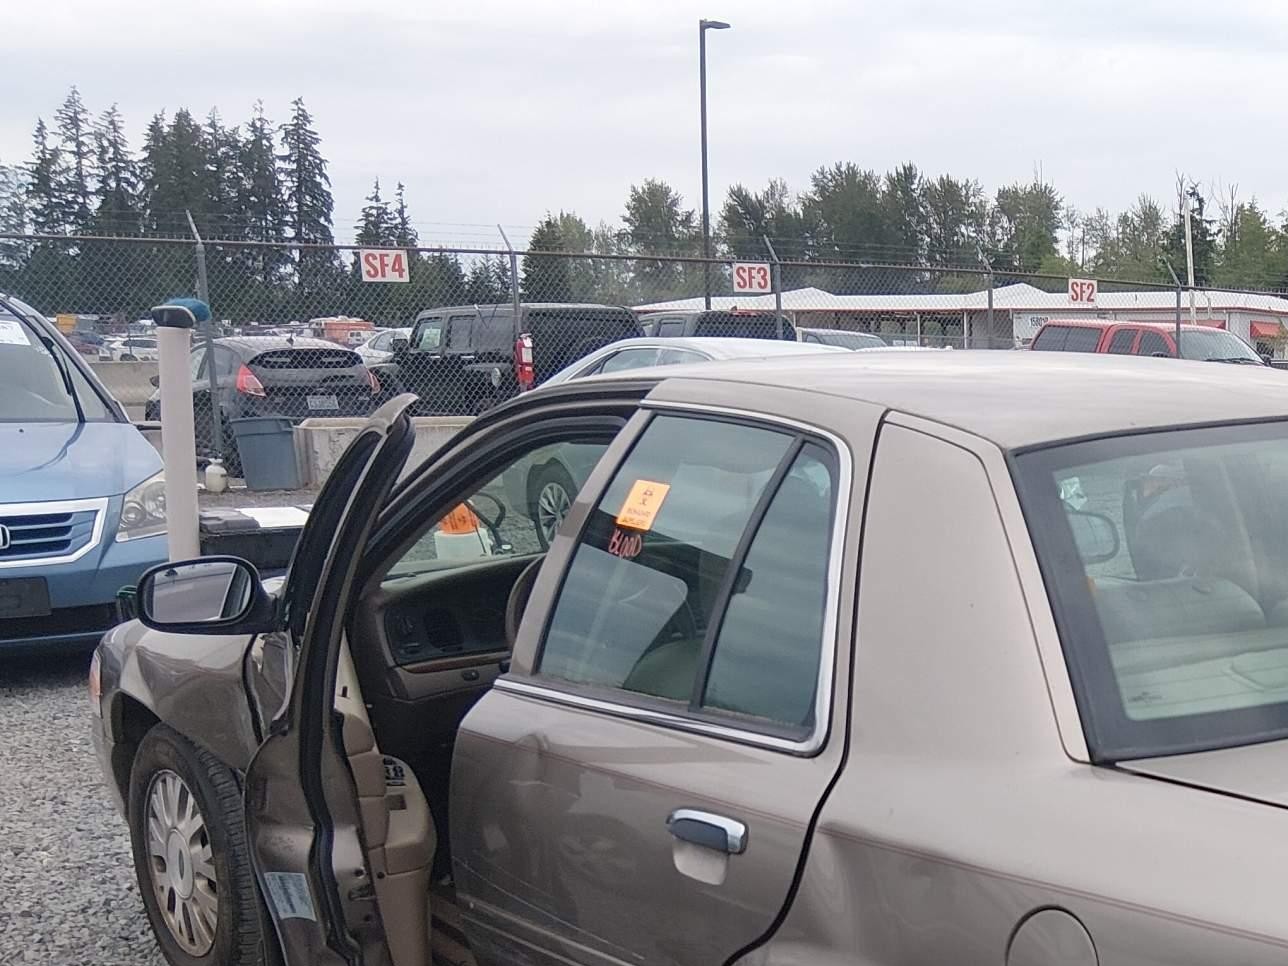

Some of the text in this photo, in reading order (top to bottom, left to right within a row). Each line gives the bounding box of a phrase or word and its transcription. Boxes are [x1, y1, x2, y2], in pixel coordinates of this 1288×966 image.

[364, 253, 406, 278] SF4
[735, 266, 769, 289] SF3
[1070, 281, 1095, 302] SF2
